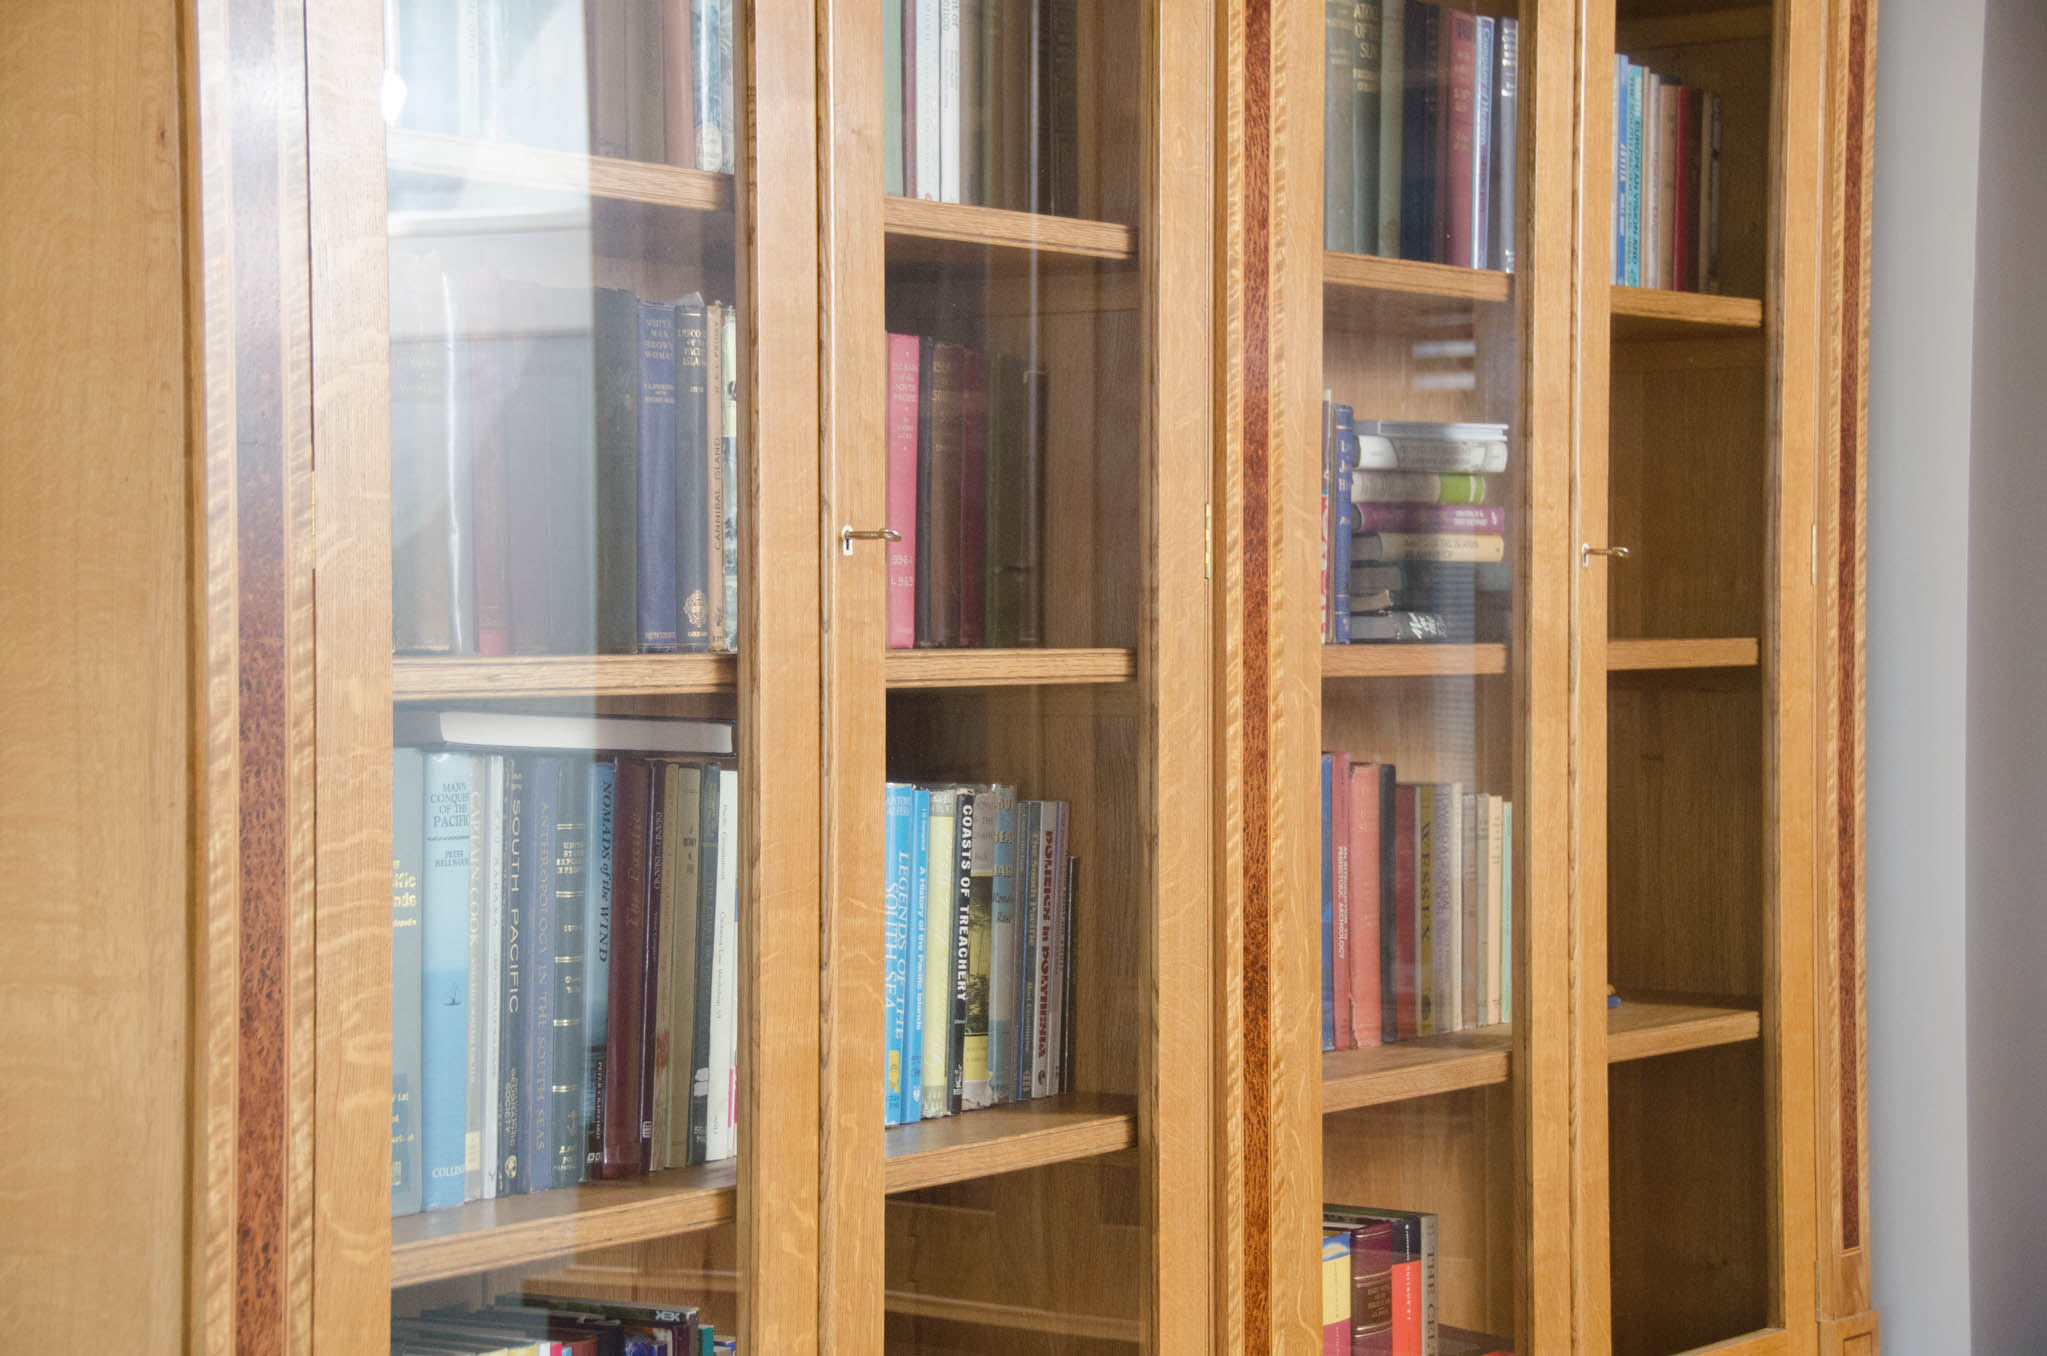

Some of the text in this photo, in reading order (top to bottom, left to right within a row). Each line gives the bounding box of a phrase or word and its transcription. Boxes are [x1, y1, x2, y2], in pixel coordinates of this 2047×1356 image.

[713, 437, 722, 552] CANNIBAL ISLAND
[439, 803, 452, 815] OF
[469, 791, 482, 882] CAPTAIN
[508, 799, 521, 1015] SOUTH PACIFIC
[599, 781, 613, 964] NOMADS of the WIND
[917, 878, 926, 918] History
[956, 804, 973, 1002] COASTS OF TREACHERY
[1421, 821, 1432, 943] WESSEX
[469, 886, 481, 948] COOK
[885, 881, 899, 961] SOUTH
[894, 851, 910, 1041] LEGENDS OF THE
[1038, 830, 1054, 1059] POLITICS in POLYNESIA
[915, 992, 923, 1031] Islands
[916, 954, 924, 990] Pacific
[535, 1035, 548, 1104] SOUTH
[534, 1107, 546, 1152] SEAS
